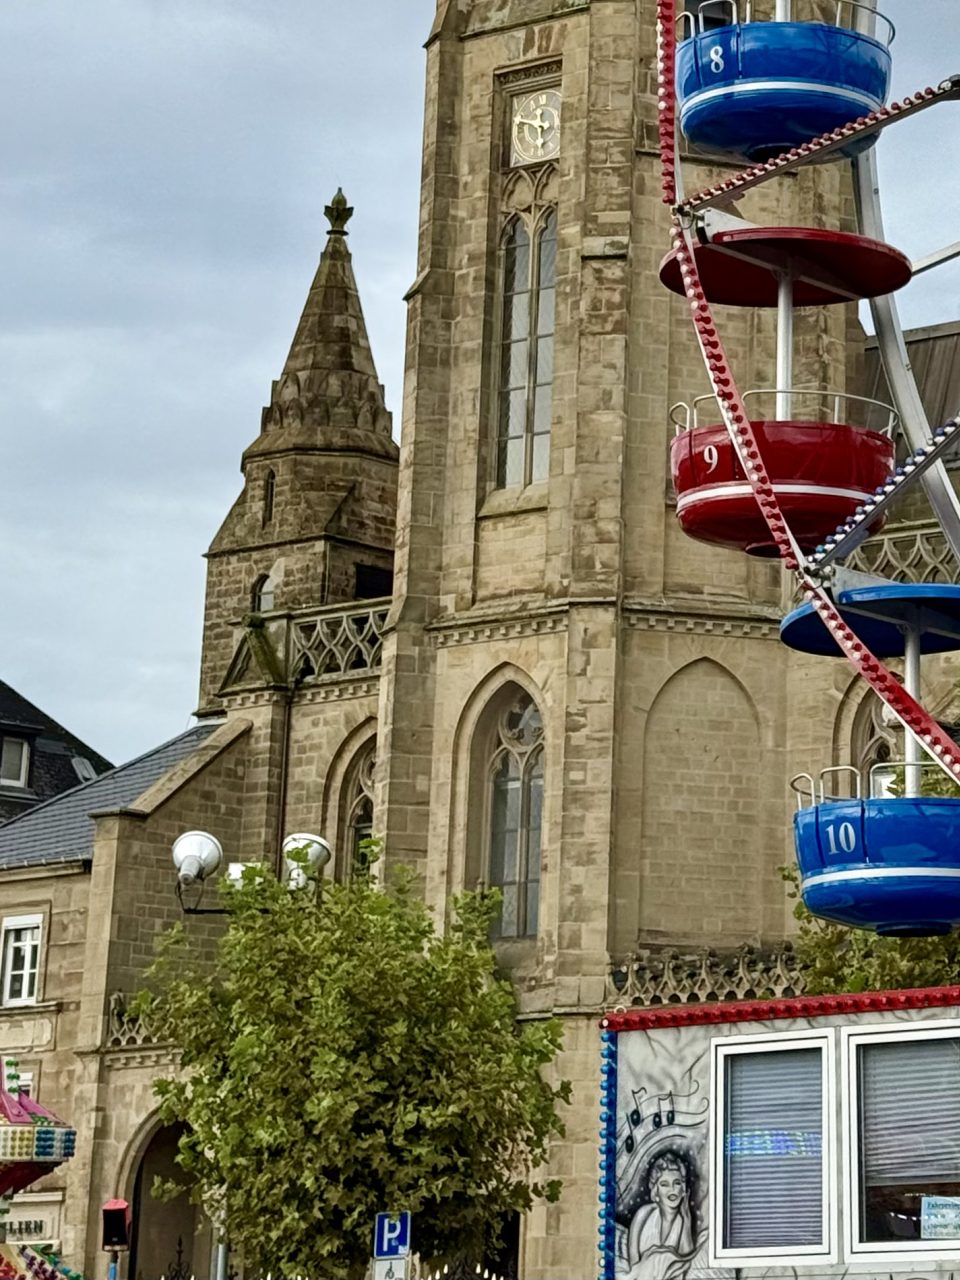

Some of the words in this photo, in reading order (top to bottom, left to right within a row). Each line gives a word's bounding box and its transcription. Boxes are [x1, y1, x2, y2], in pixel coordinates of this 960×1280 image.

[709, 45, 724, 73] 8
[703, 445, 718, 475] 9
[825, 822, 856, 855] 10
[382, 1218, 401, 1252] P
